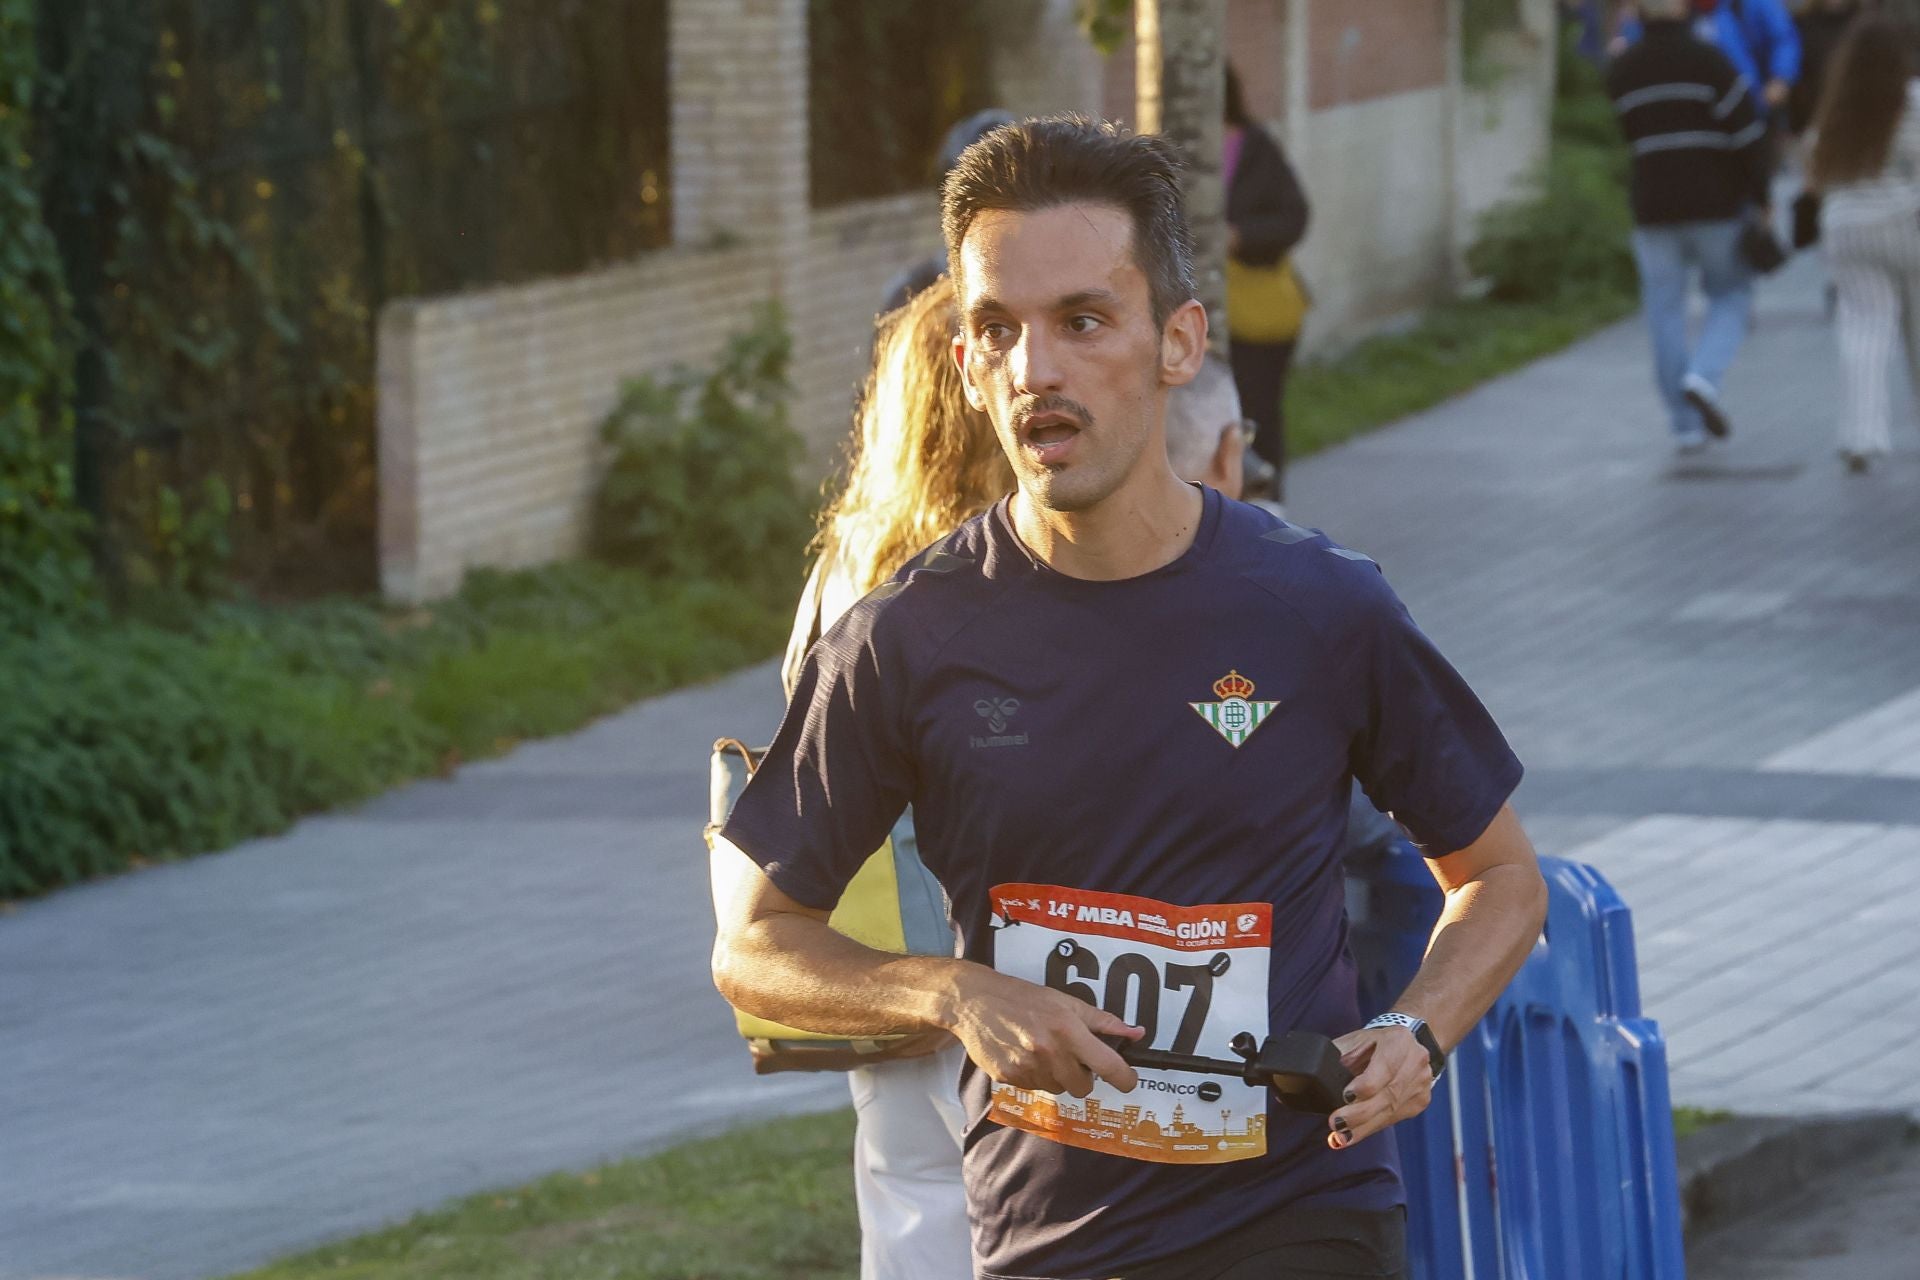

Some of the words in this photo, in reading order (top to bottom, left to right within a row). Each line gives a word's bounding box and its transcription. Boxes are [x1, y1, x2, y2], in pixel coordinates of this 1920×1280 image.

[1077, 906, 1135, 928] MBA
[1178, 918, 1226, 939] GIJÓN
[1046, 943, 1213, 1055] 607
